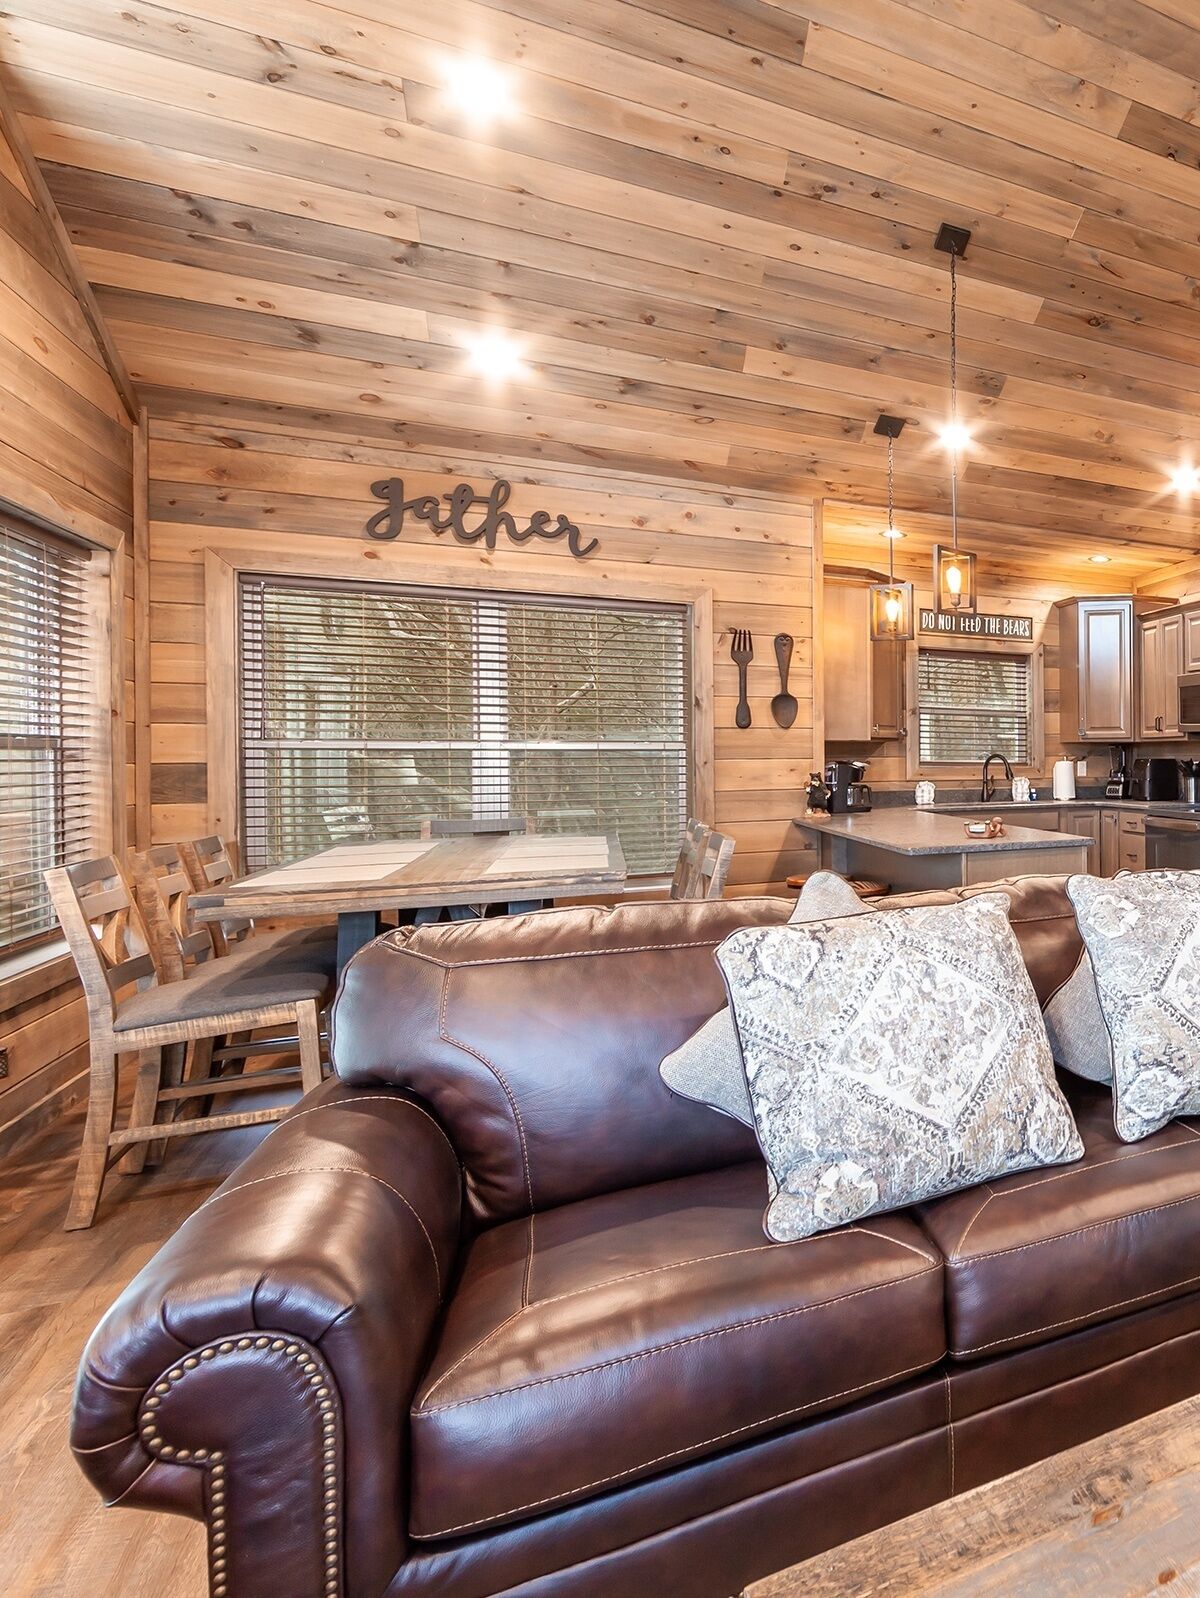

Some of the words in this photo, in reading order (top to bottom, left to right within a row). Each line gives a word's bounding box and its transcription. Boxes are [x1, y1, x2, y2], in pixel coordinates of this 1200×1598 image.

[366, 477, 599, 557] gather
[922, 612, 935, 629] DO
[960, 616, 982, 633] FEED
[984, 617, 1001, 634] THE
[1003, 619, 1030, 636] BEARS
